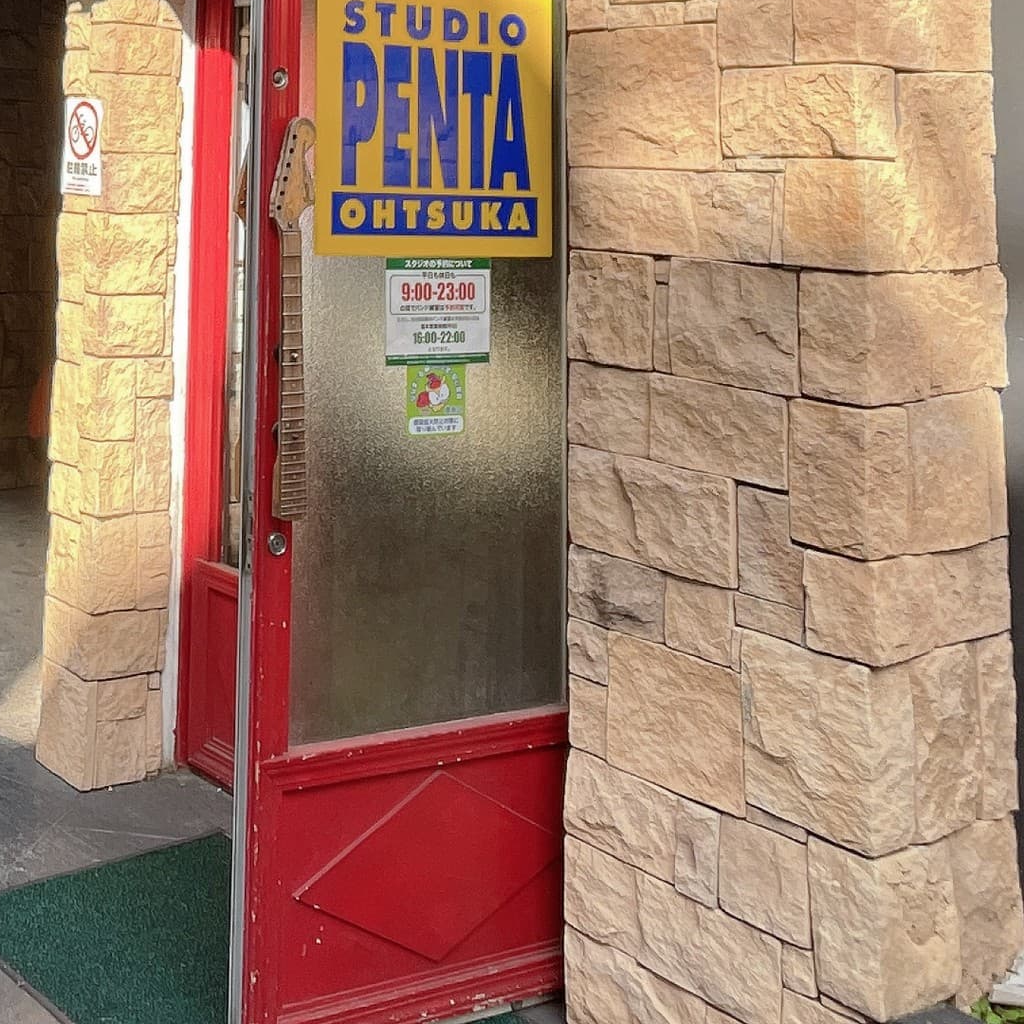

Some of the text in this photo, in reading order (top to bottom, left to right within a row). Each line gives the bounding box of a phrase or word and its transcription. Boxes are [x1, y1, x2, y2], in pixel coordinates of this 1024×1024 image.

[343, 0, 527, 47] STUDIO
[341, 41, 531, 192] PENTA
[339, 198, 531, 231] OHTSUKA
[401, 282, 476, 302] 9:00-23:00
[413, 331, 465, 345] 16:00-22:00
